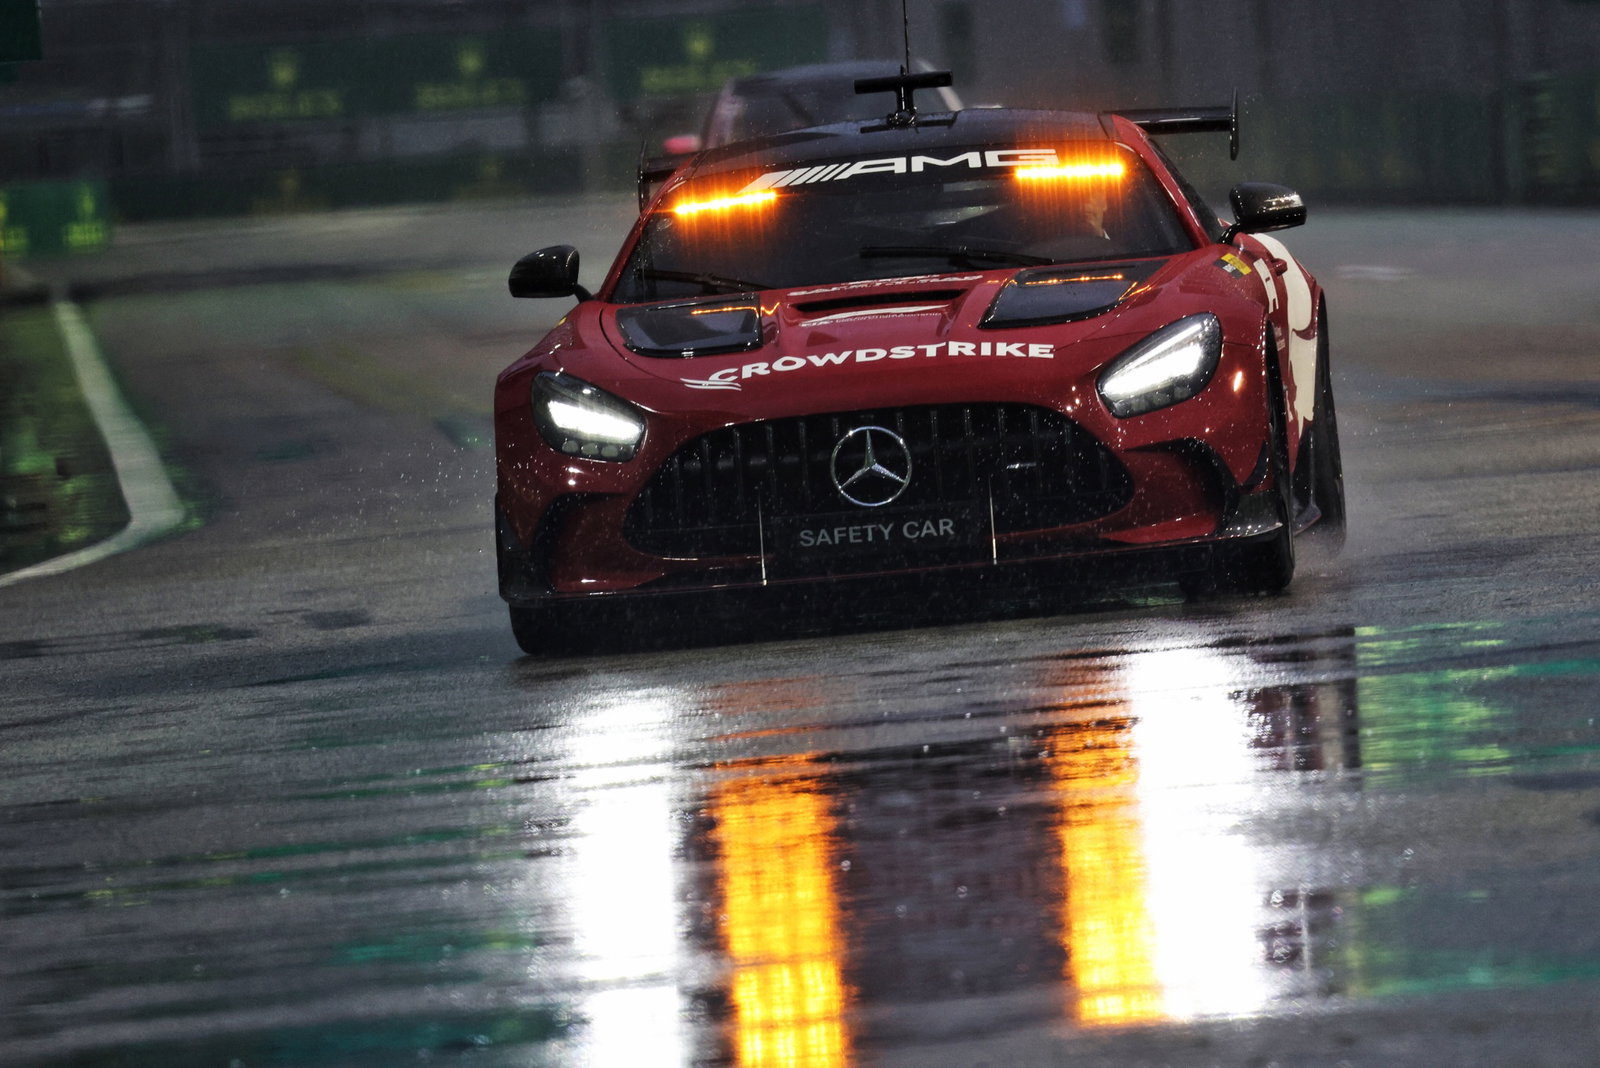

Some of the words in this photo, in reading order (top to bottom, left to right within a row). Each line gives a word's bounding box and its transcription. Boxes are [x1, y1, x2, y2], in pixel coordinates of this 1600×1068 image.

[834, 148, 1060, 181] AMG
[706, 341, 1055, 383] CROWDSTRIKE
[799, 523, 895, 548] SAFETY
[902, 517, 955, 539] CAR
